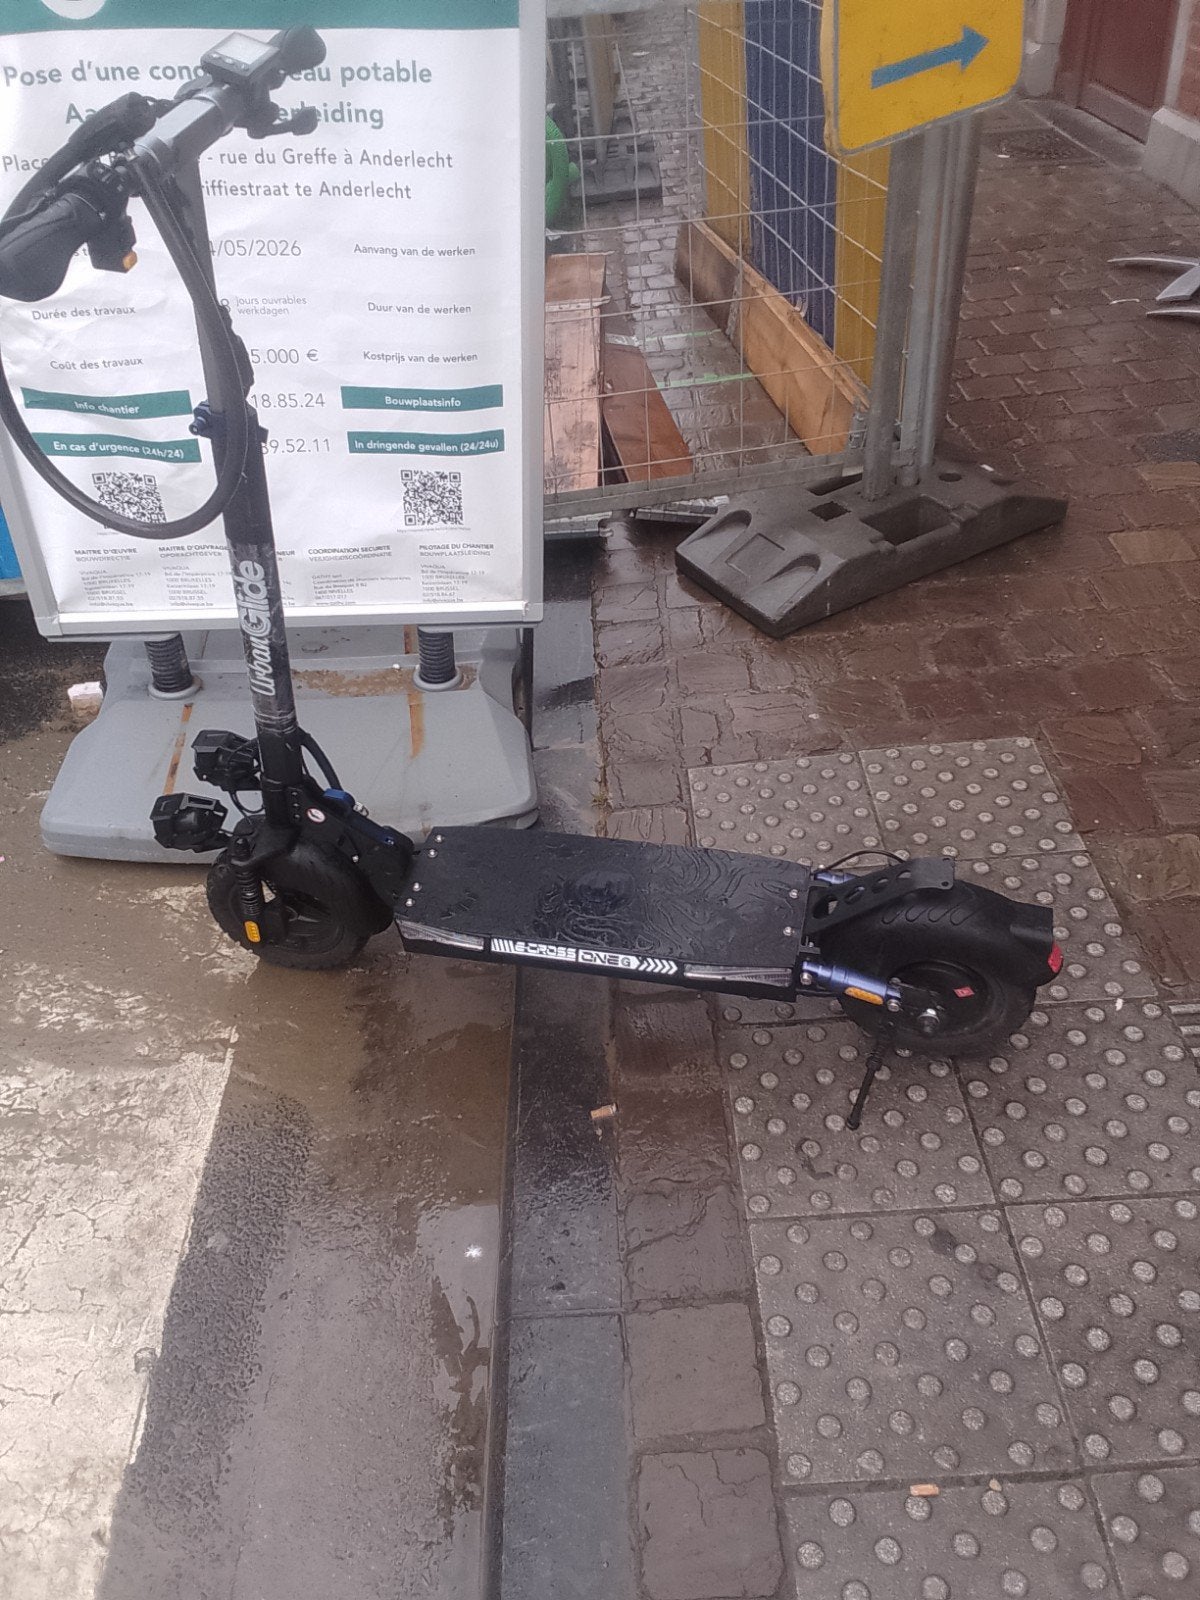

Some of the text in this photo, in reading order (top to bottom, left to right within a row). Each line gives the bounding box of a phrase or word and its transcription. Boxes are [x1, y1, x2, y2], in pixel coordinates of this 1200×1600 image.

[3, 65, 63, 87] Pose
[71, 59, 140, 82] d'une
[340, 60, 433, 88] potable
[219, 152, 248, 165] rue
[254, 148, 276, 165] du
[282, 147, 337, 165] Greffe
[343, 148, 353, 166] à
[359, 148, 453, 168] Anderlecht
[295, 182, 313, 197] te
[318, 180, 412, 200] Anderlecht
[353, 243, 476, 258] Aanvang van de werken
[235, 296, 260, 307] jours
[262, 294, 308, 305] ouvrables
[32, 305, 137, 321] Durée des travaux
[237, 306, 290, 317] werkdagen
[367, 302, 472, 315] Duur van de werken
[306, 348, 319, 362] €
[362, 351, 478, 364] Kostprijs van de werken
[49, 357, 144, 370] Coût des travaux
[74, 400, 140, 415] Info chantier
[384, 396, 462, 409] Bouwplaatsinfo
[53, 441, 185, 460] En cas d'urgence (24h/24)
[354, 437, 499, 455] In dringende gevallen (24/24u)
[234, 559, 276, 697] UrbanGlide
